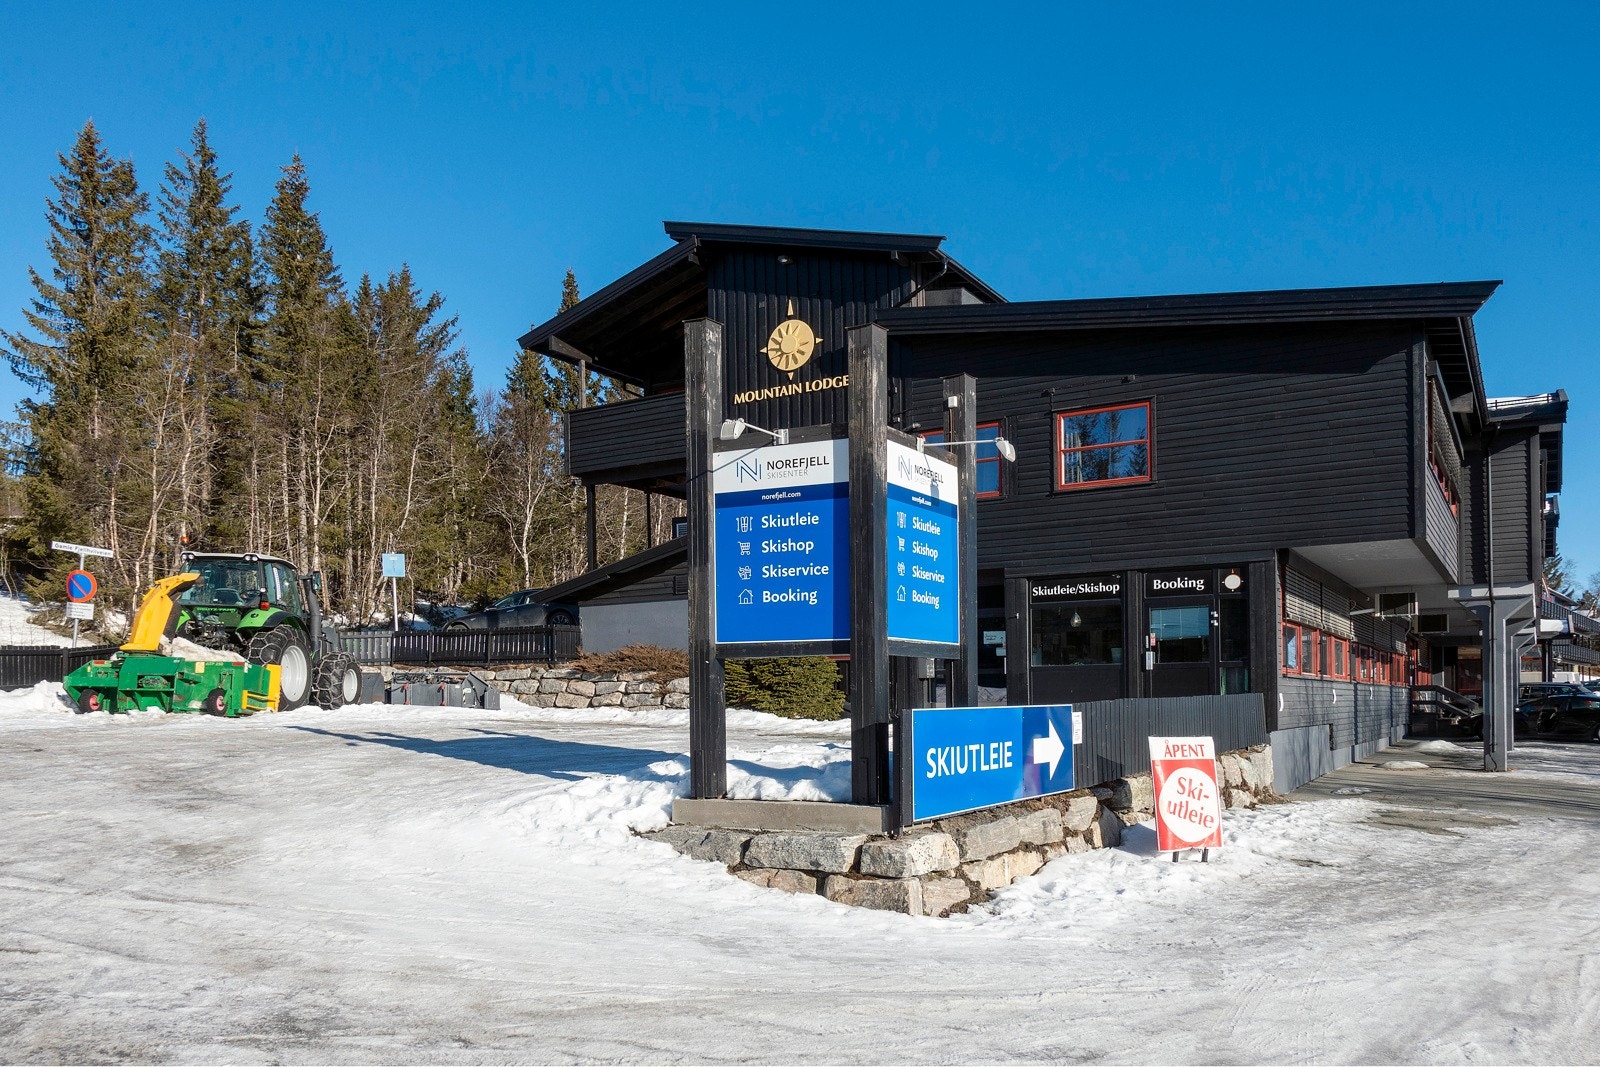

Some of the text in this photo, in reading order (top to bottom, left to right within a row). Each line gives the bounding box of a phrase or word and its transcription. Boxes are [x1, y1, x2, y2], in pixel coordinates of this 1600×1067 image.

[734, 375, 849, 404] MOUNTAIN LODGE
[766, 456, 829, 471] NOREFJELL
[767, 469, 809, 480] SKISENTER
[761, 491, 802, 501] norefjell.com
[761, 512, 819, 529] Skiutleie
[912, 516, 941, 536] Skiutleie
[761, 539, 814, 554] Skishop
[912, 541, 939, 562] Skishop
[761, 563, 829, 578] Skiservice
[912, 567, 945, 584] Skiservice
[1032, 582, 1120, 597] Skiutleie/Skishop
[1153, 578, 1205, 591] Booking
[762, 588, 817, 605] Booking
[912, 590, 940, 610] Booking
[1164, 739, 1205, 758] ÅPENT
[926, 741, 1013, 780] SKIUTLEIE
[1176, 776, 1210, 801] Ski-
[1167, 800, 1215, 829] utleie
